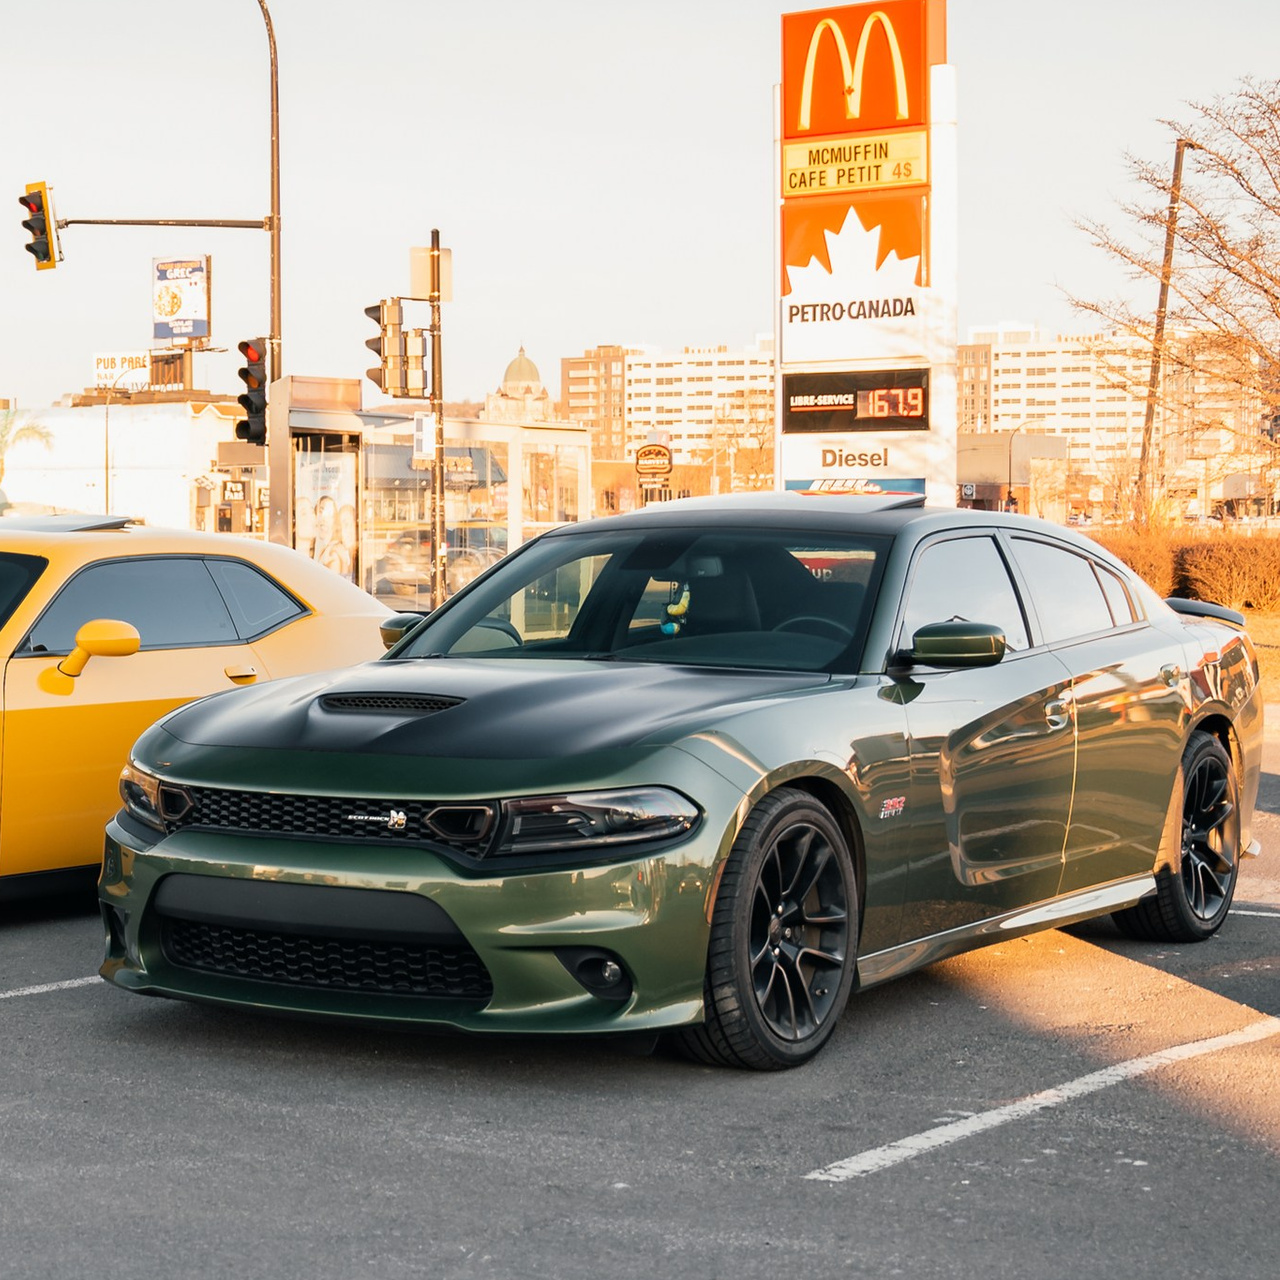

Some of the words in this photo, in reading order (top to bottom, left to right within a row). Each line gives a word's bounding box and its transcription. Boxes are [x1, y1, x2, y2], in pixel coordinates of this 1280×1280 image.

[808, 142, 888, 166] MCMUFFIN
[789, 170, 827, 189] CAFE
[837, 164, 882, 184] PETIT
[892, 162, 913, 179] 4$
[789, 297, 916, 323] PETRO-CANADA
[96, 357, 117, 370] PUB
[790, 394, 855, 407] LIBRE-SERVICE
[868, 387, 924, 418] 167.9
[821, 448, 888, 467] Diesel
